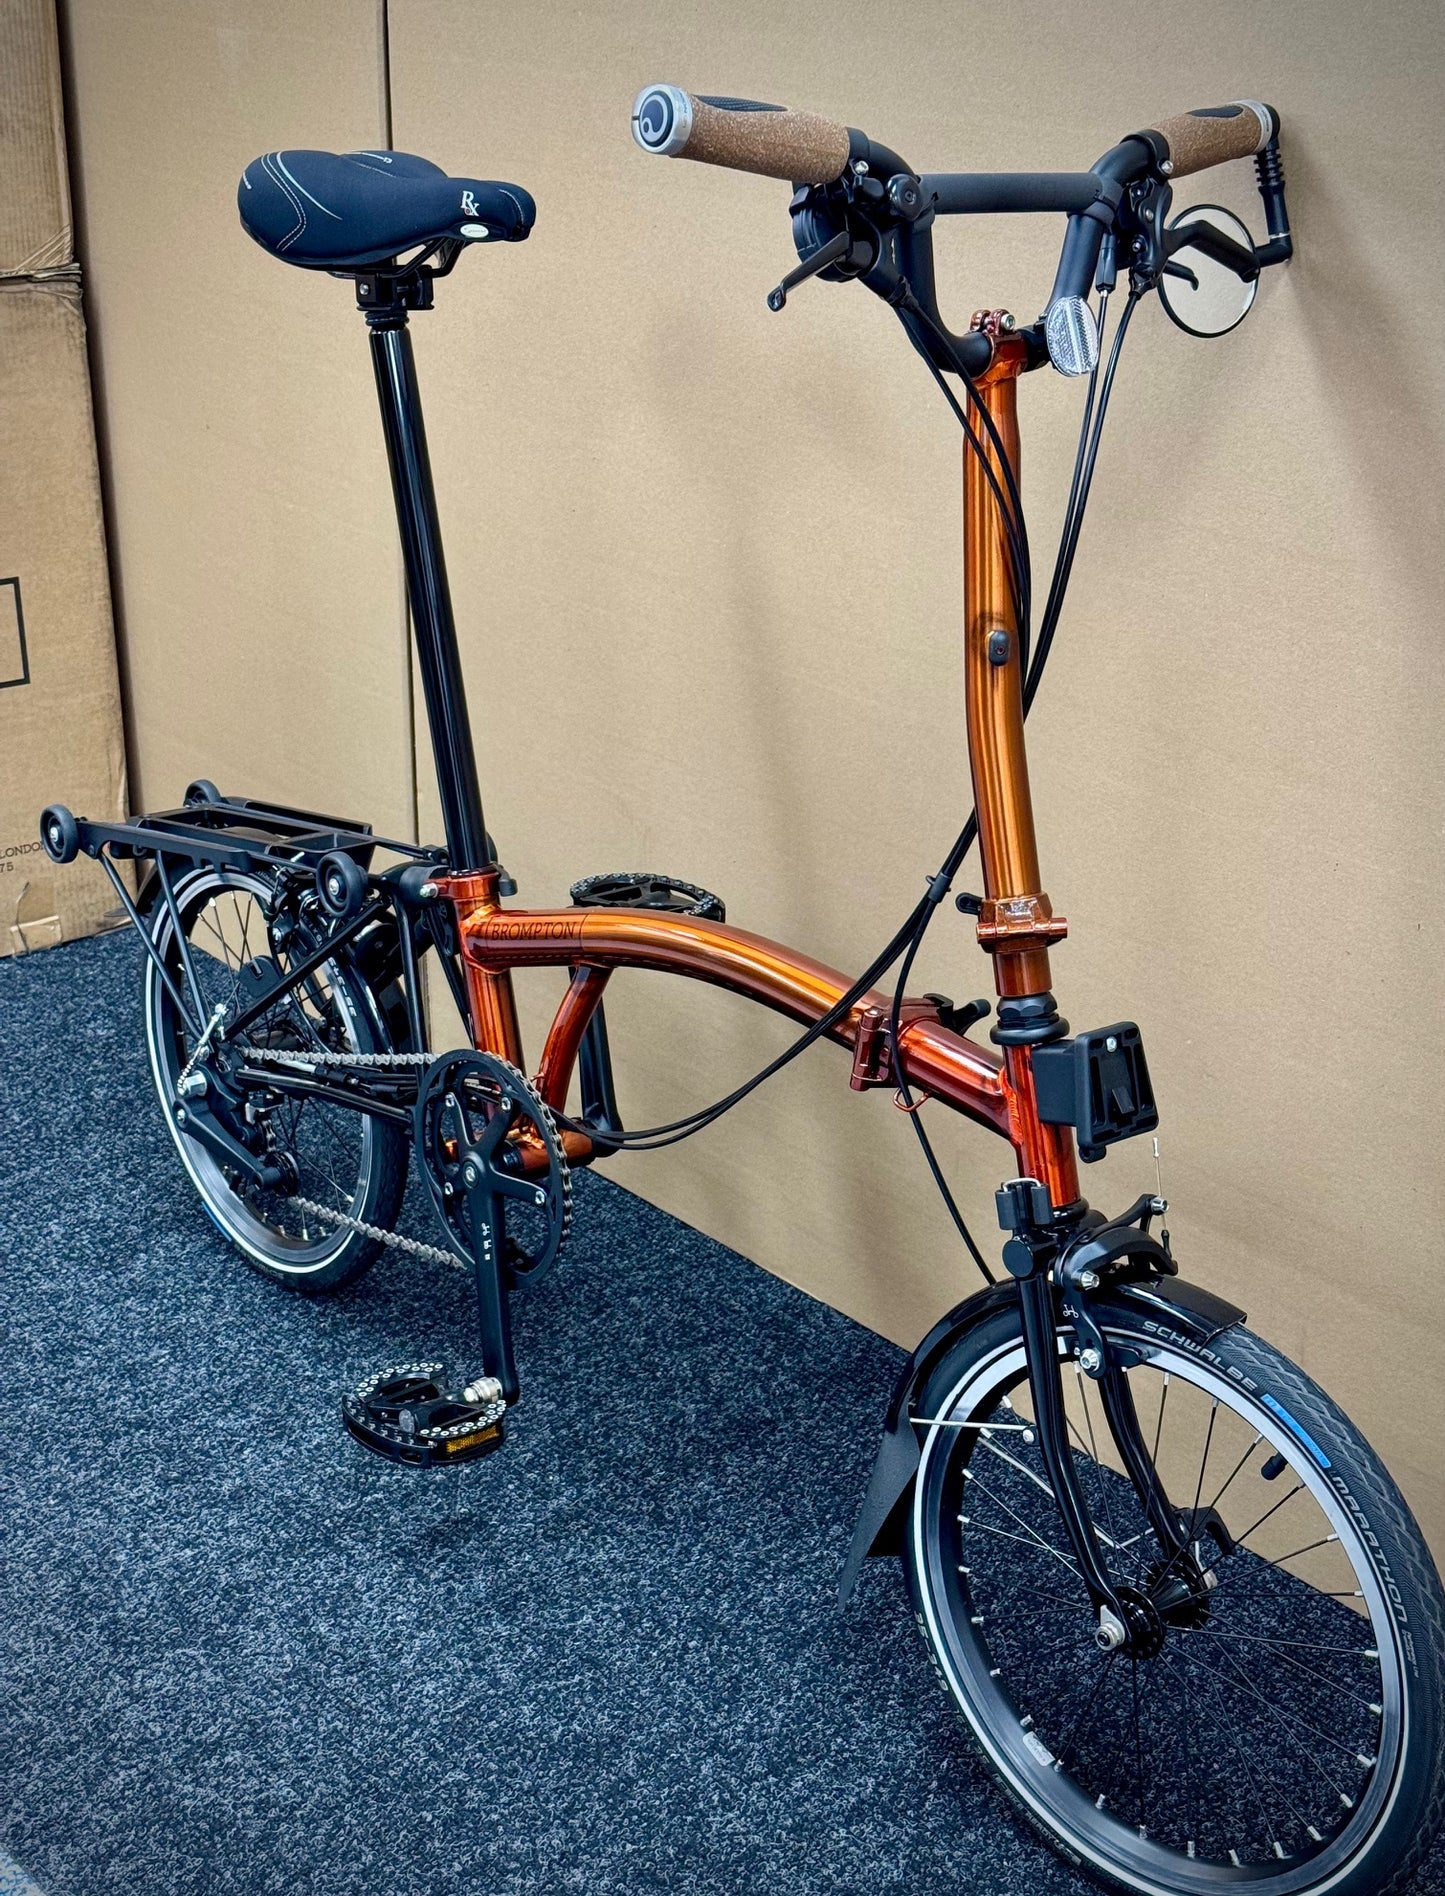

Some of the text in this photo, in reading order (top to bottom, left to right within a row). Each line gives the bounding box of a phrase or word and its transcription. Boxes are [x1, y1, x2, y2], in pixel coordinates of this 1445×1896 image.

[491, 921, 577, 941] BROMPTON
[1142, 1320, 1258, 1391] SCHWALBE
[1332, 1476, 1408, 1623] MARATHON
